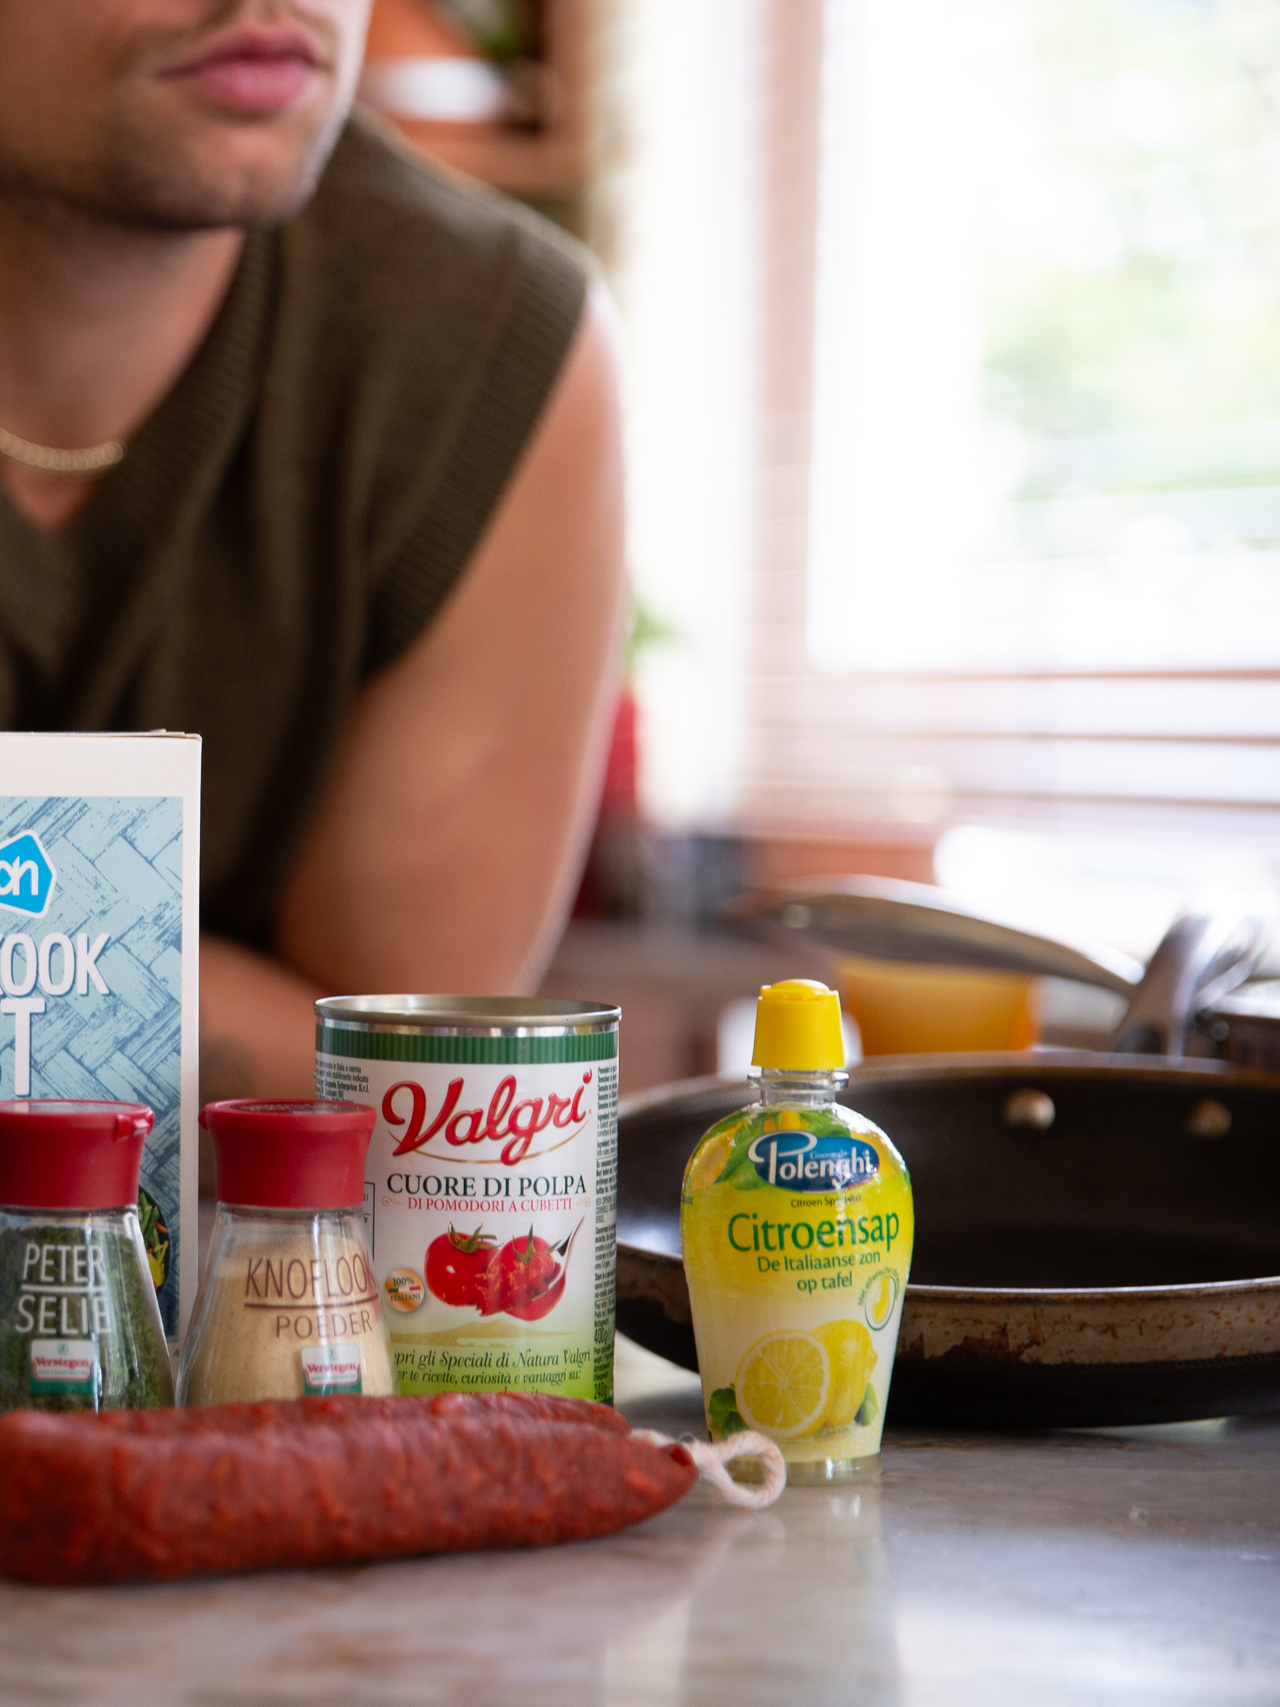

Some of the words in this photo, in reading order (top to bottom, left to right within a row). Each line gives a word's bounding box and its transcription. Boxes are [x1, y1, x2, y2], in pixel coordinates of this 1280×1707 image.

[748, 1130, 872, 1186] Polenghi
[387, 1173, 476, 1197] CUORE
[483, 1176, 512, 1198] DI
[519, 1174, 587, 1197] POLPA
[408, 1196, 422, 1210] DI
[426, 1197, 504, 1212] POMODORI
[509, 1199, 518, 1212] A
[521, 1197, 572, 1212] CUBETTI
[790, 1198, 823, 1208] Citroen
[728, 1212, 899, 1252] Citroensap
[22, 1244, 106, 1283] PETER
[757, 1256, 780, 1272] De
[784, 1254, 856, 1271] Italiaanse
[859, 1251, 881, 1265] zon
[392, 1276, 415, 1286] 100%
[797, 1279, 817, 1295] op
[821, 1271, 853, 1290] tafel
[276, 1310, 373, 1339] POEDER
[394, 1349, 415, 1367] pri
[418, 1350, 436, 1371] gli
[440, 1350, 491, 1371] Speciali
[496, 1351, 509, 1368] di
[513, 1349, 559, 1368] Natura
[410, 1370, 420, 1381] te
[422, 1370, 458, 1385] ricette,
[461, 1371, 512, 1385] curiosità
[523, 1368, 567, 1386] vantaggi
